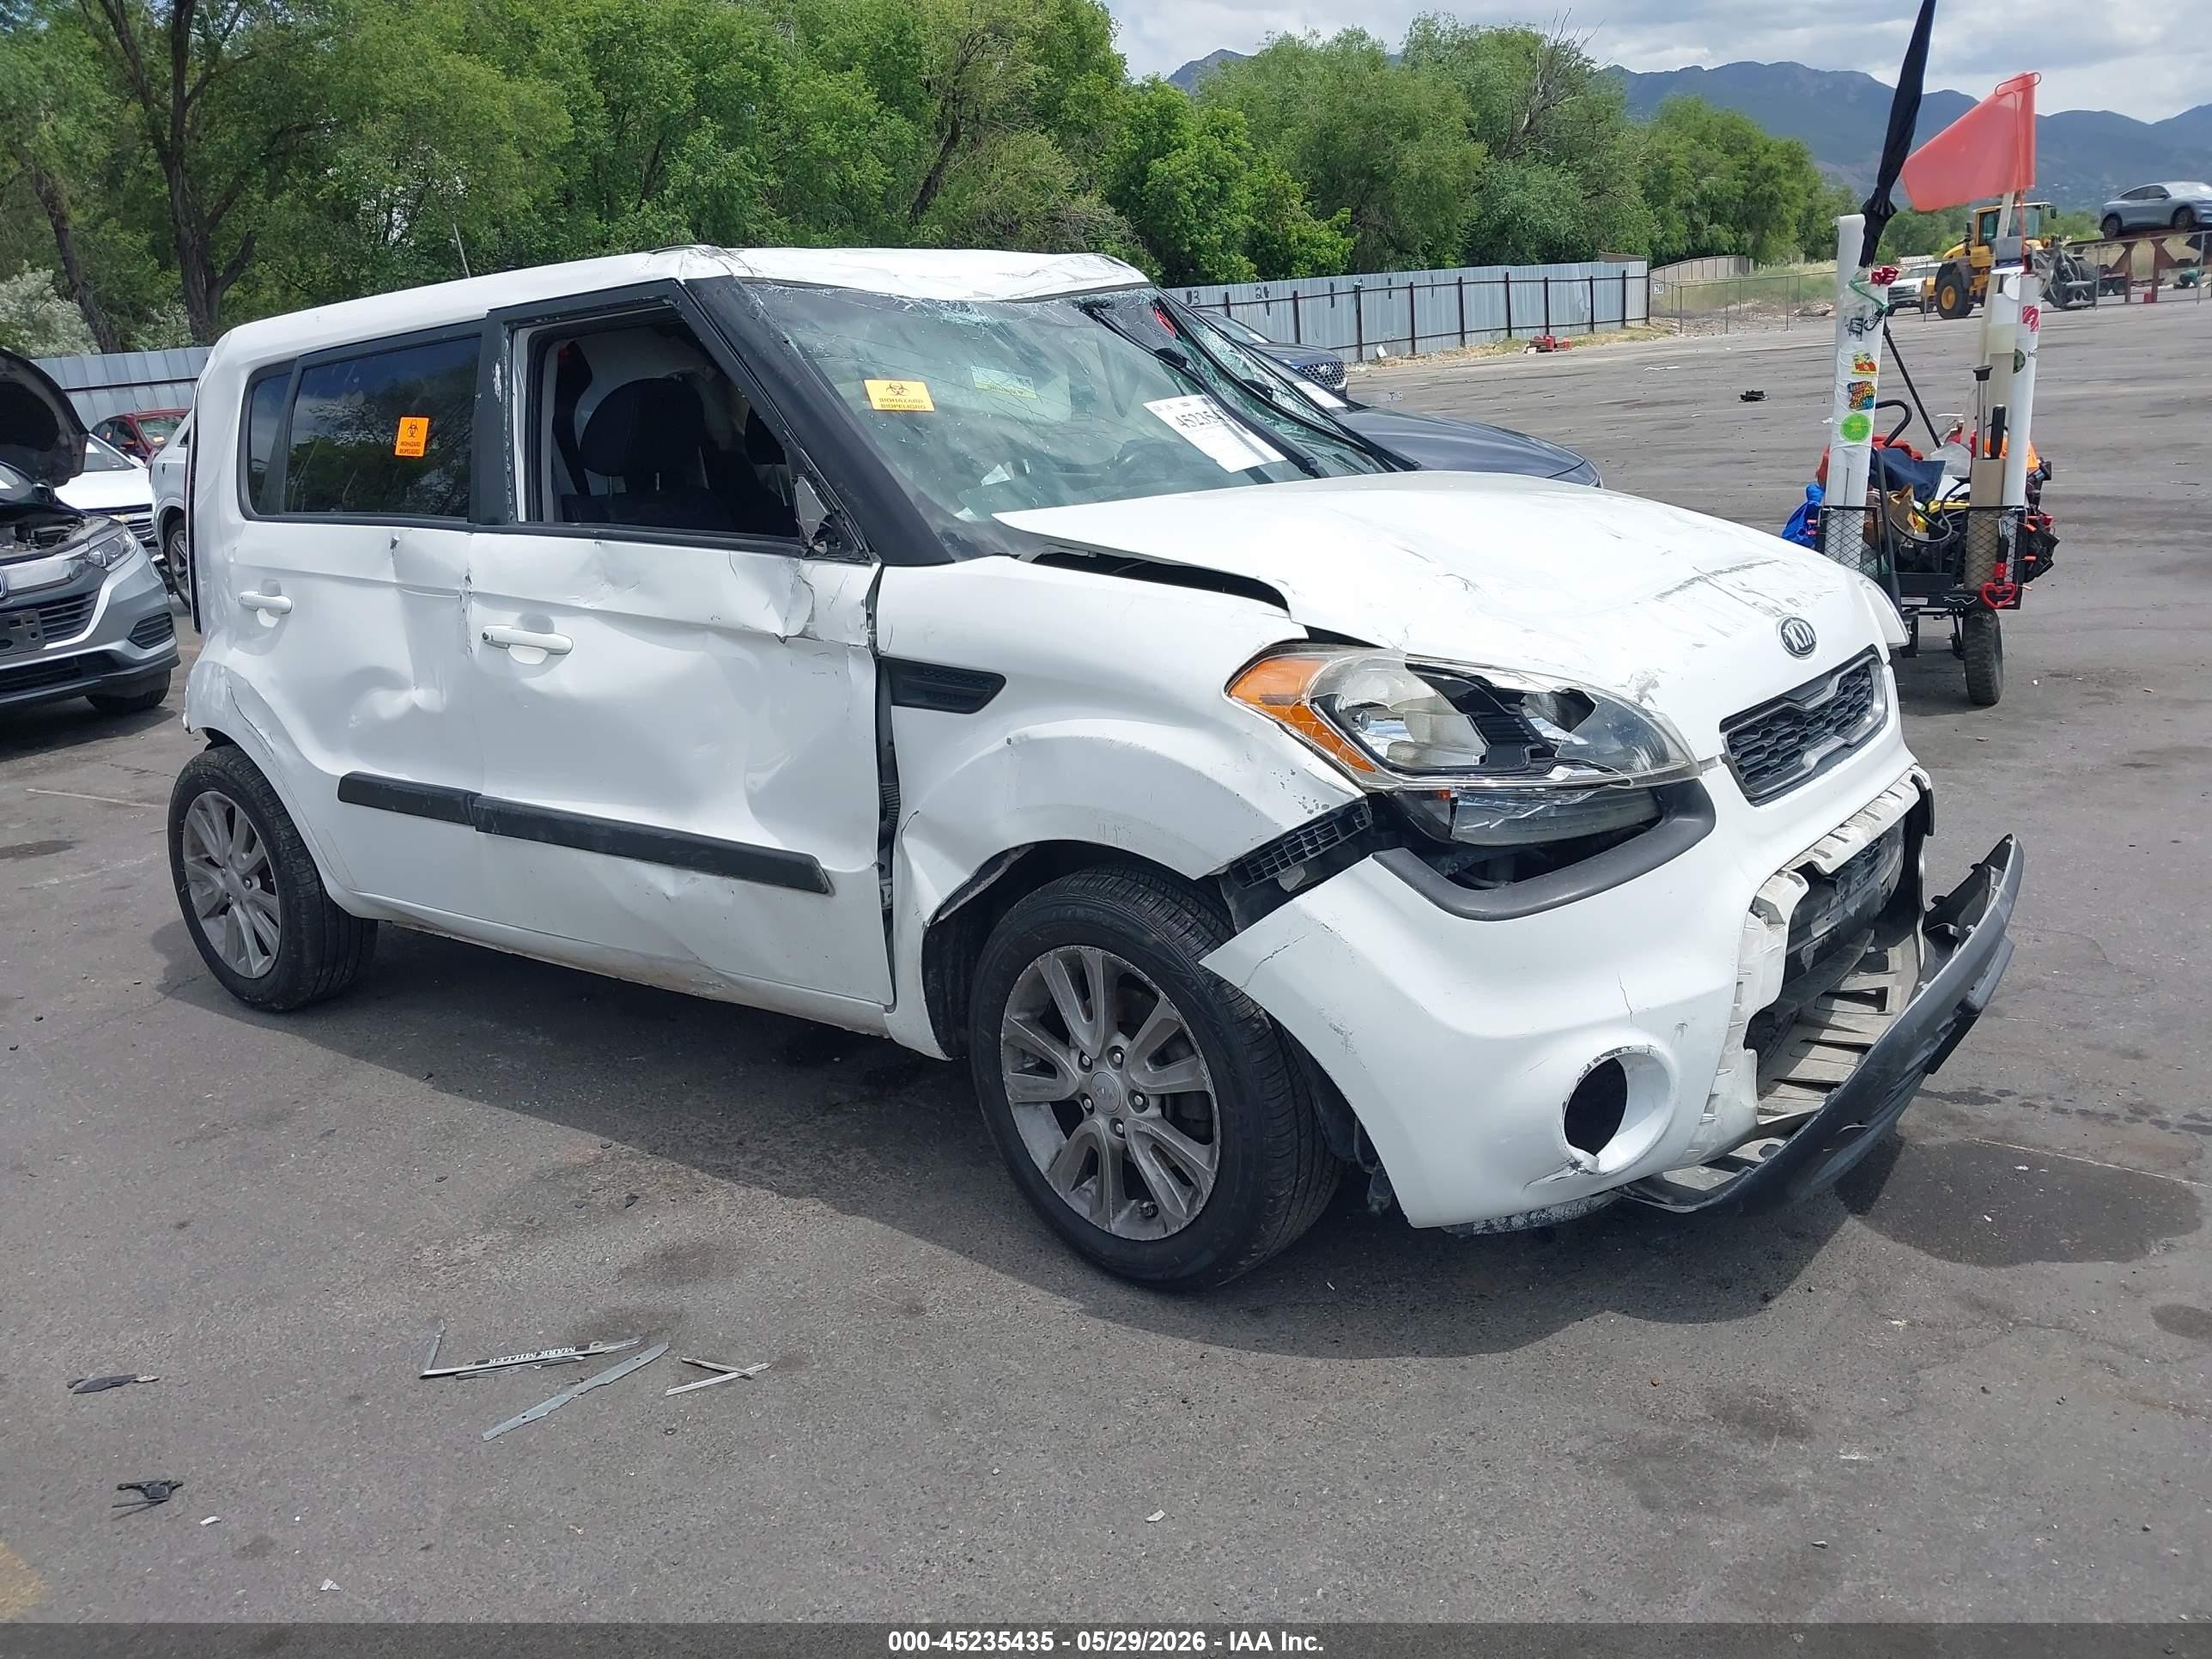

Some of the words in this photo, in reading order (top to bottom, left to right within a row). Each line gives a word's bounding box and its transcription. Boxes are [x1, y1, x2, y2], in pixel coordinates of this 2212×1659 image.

[1782, 619, 1817, 652] KIA
[1091, 1085, 1118, 1100] KIA
[489, 1352, 538, 1364] MILLER
[539, 1346, 577, 1357] MARK
